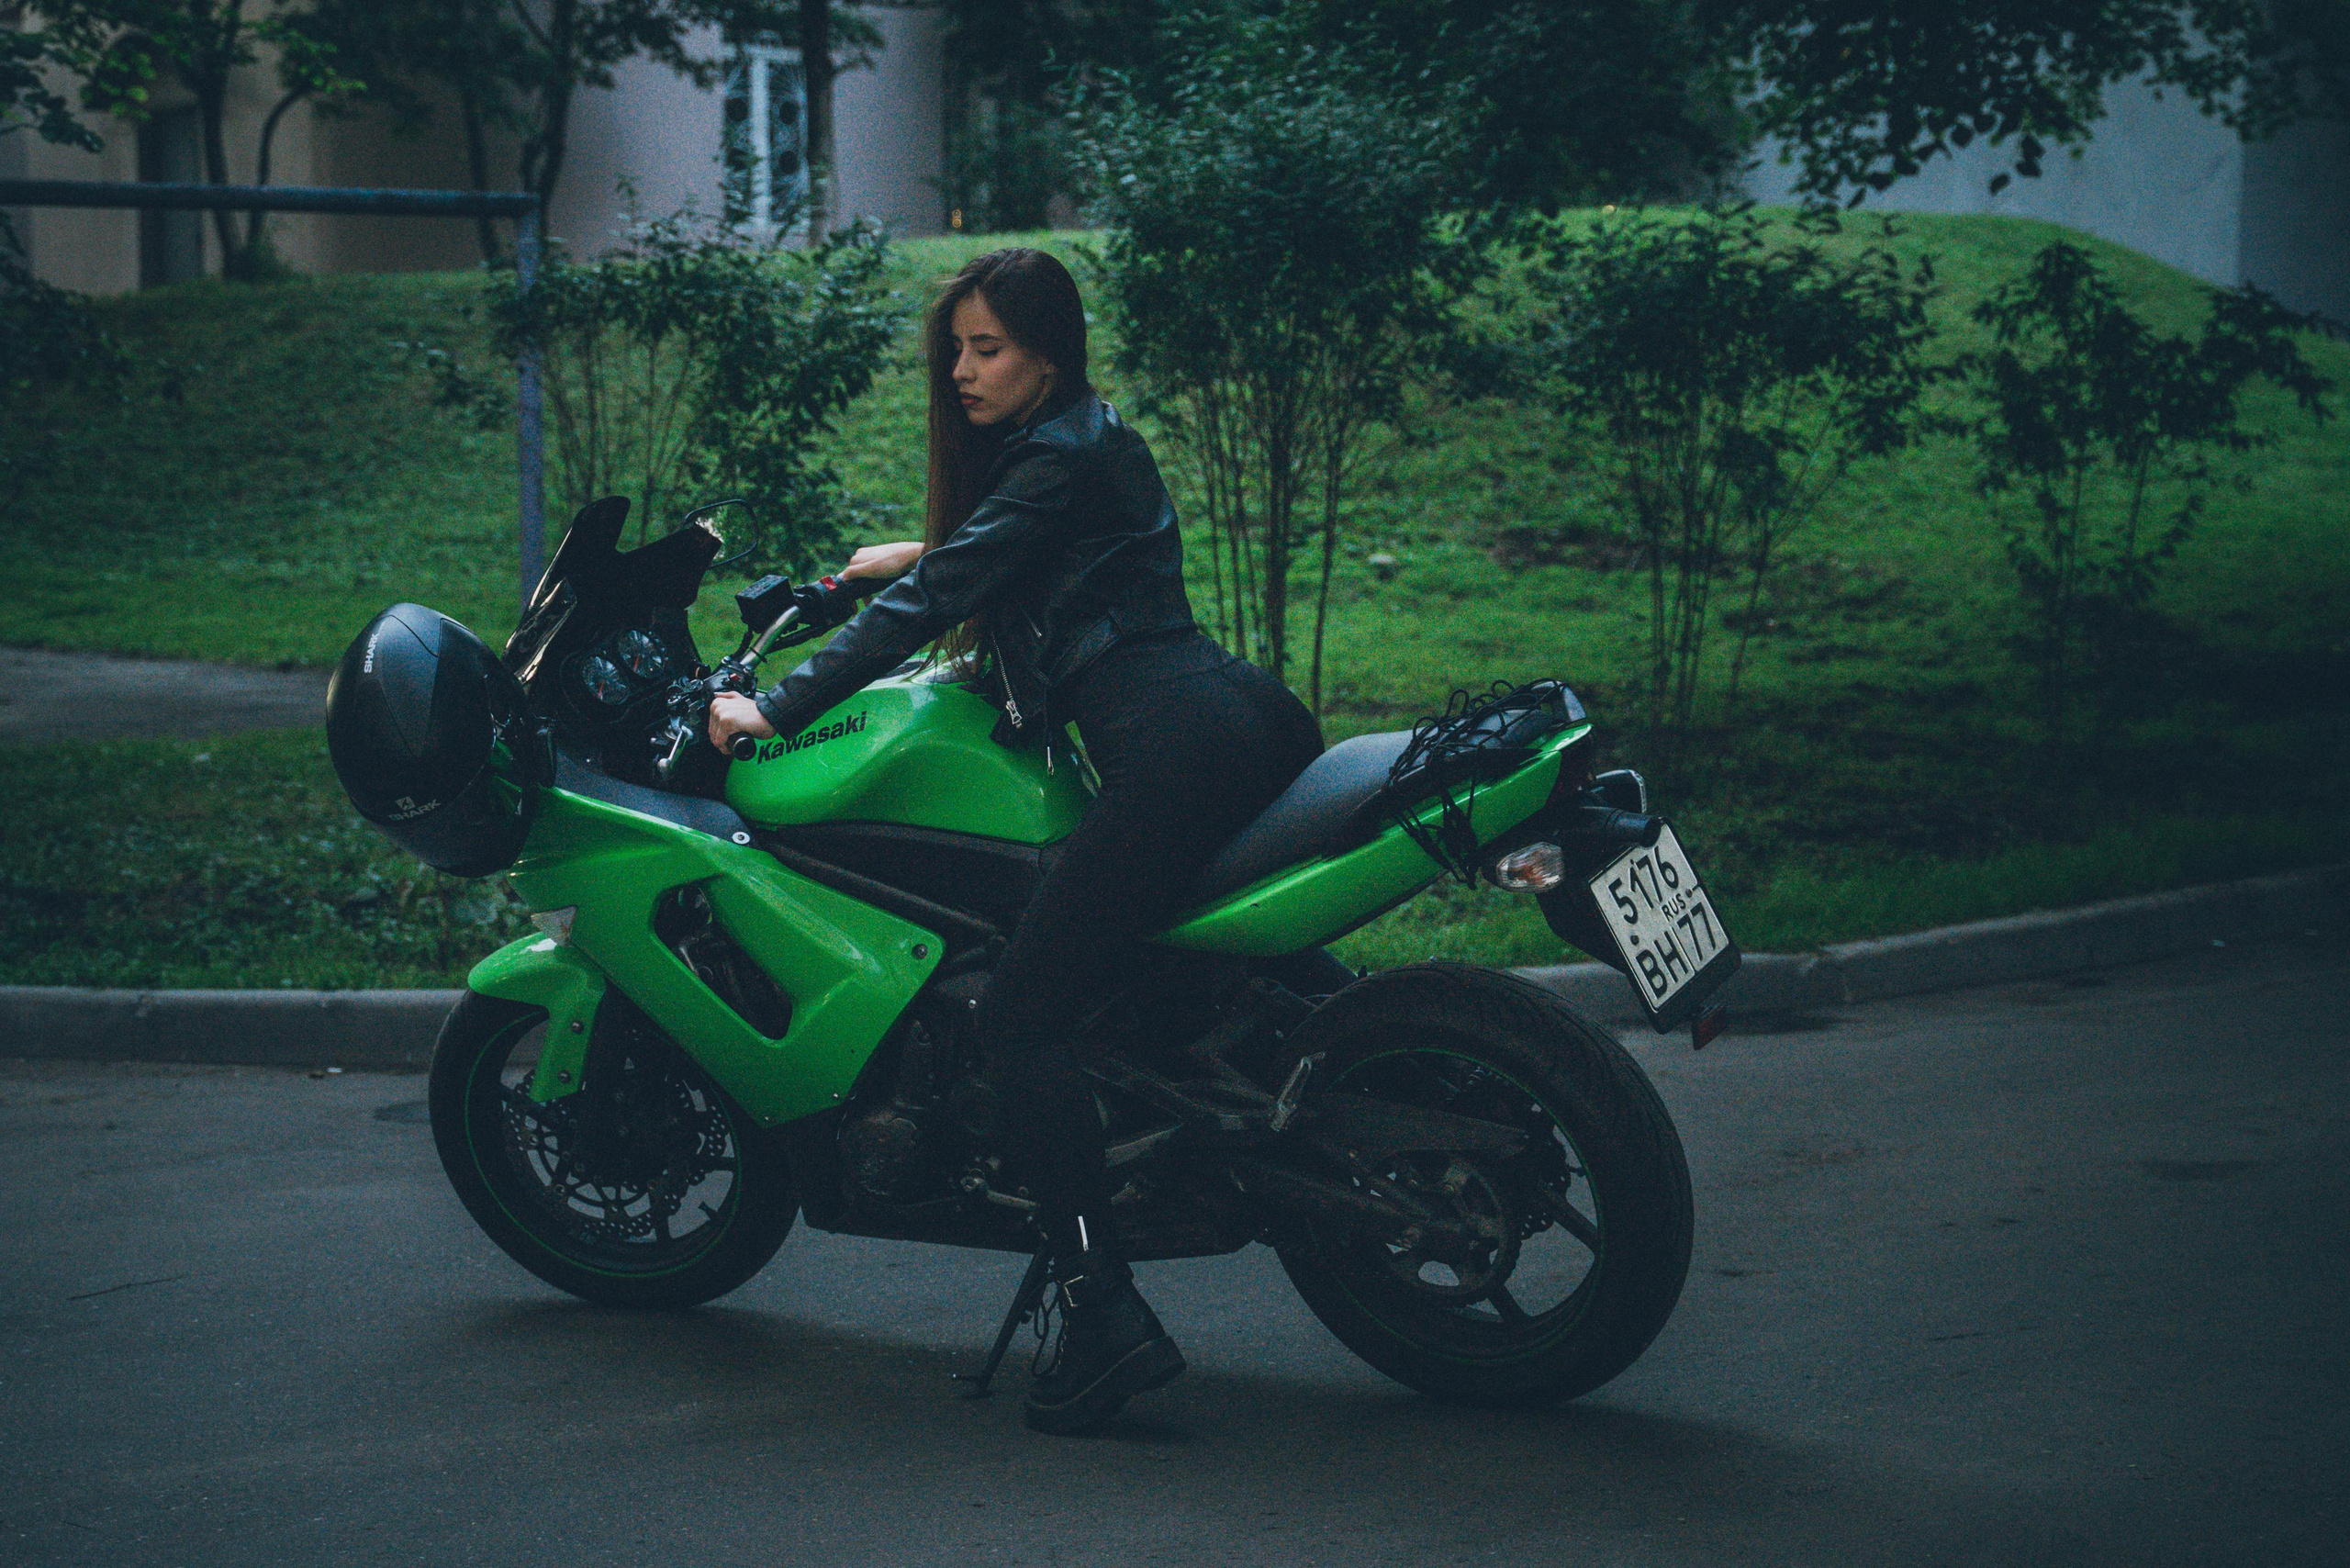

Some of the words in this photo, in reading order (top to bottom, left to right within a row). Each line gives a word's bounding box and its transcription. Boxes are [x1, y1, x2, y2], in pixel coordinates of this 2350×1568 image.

[364, 633, 379, 674] SHARK
[757, 711, 867, 765] Kawasaki
[1608, 846, 1679, 924] 5176
[1662, 893, 1686, 923] RUS
[1678, 902, 1717, 962] 77
